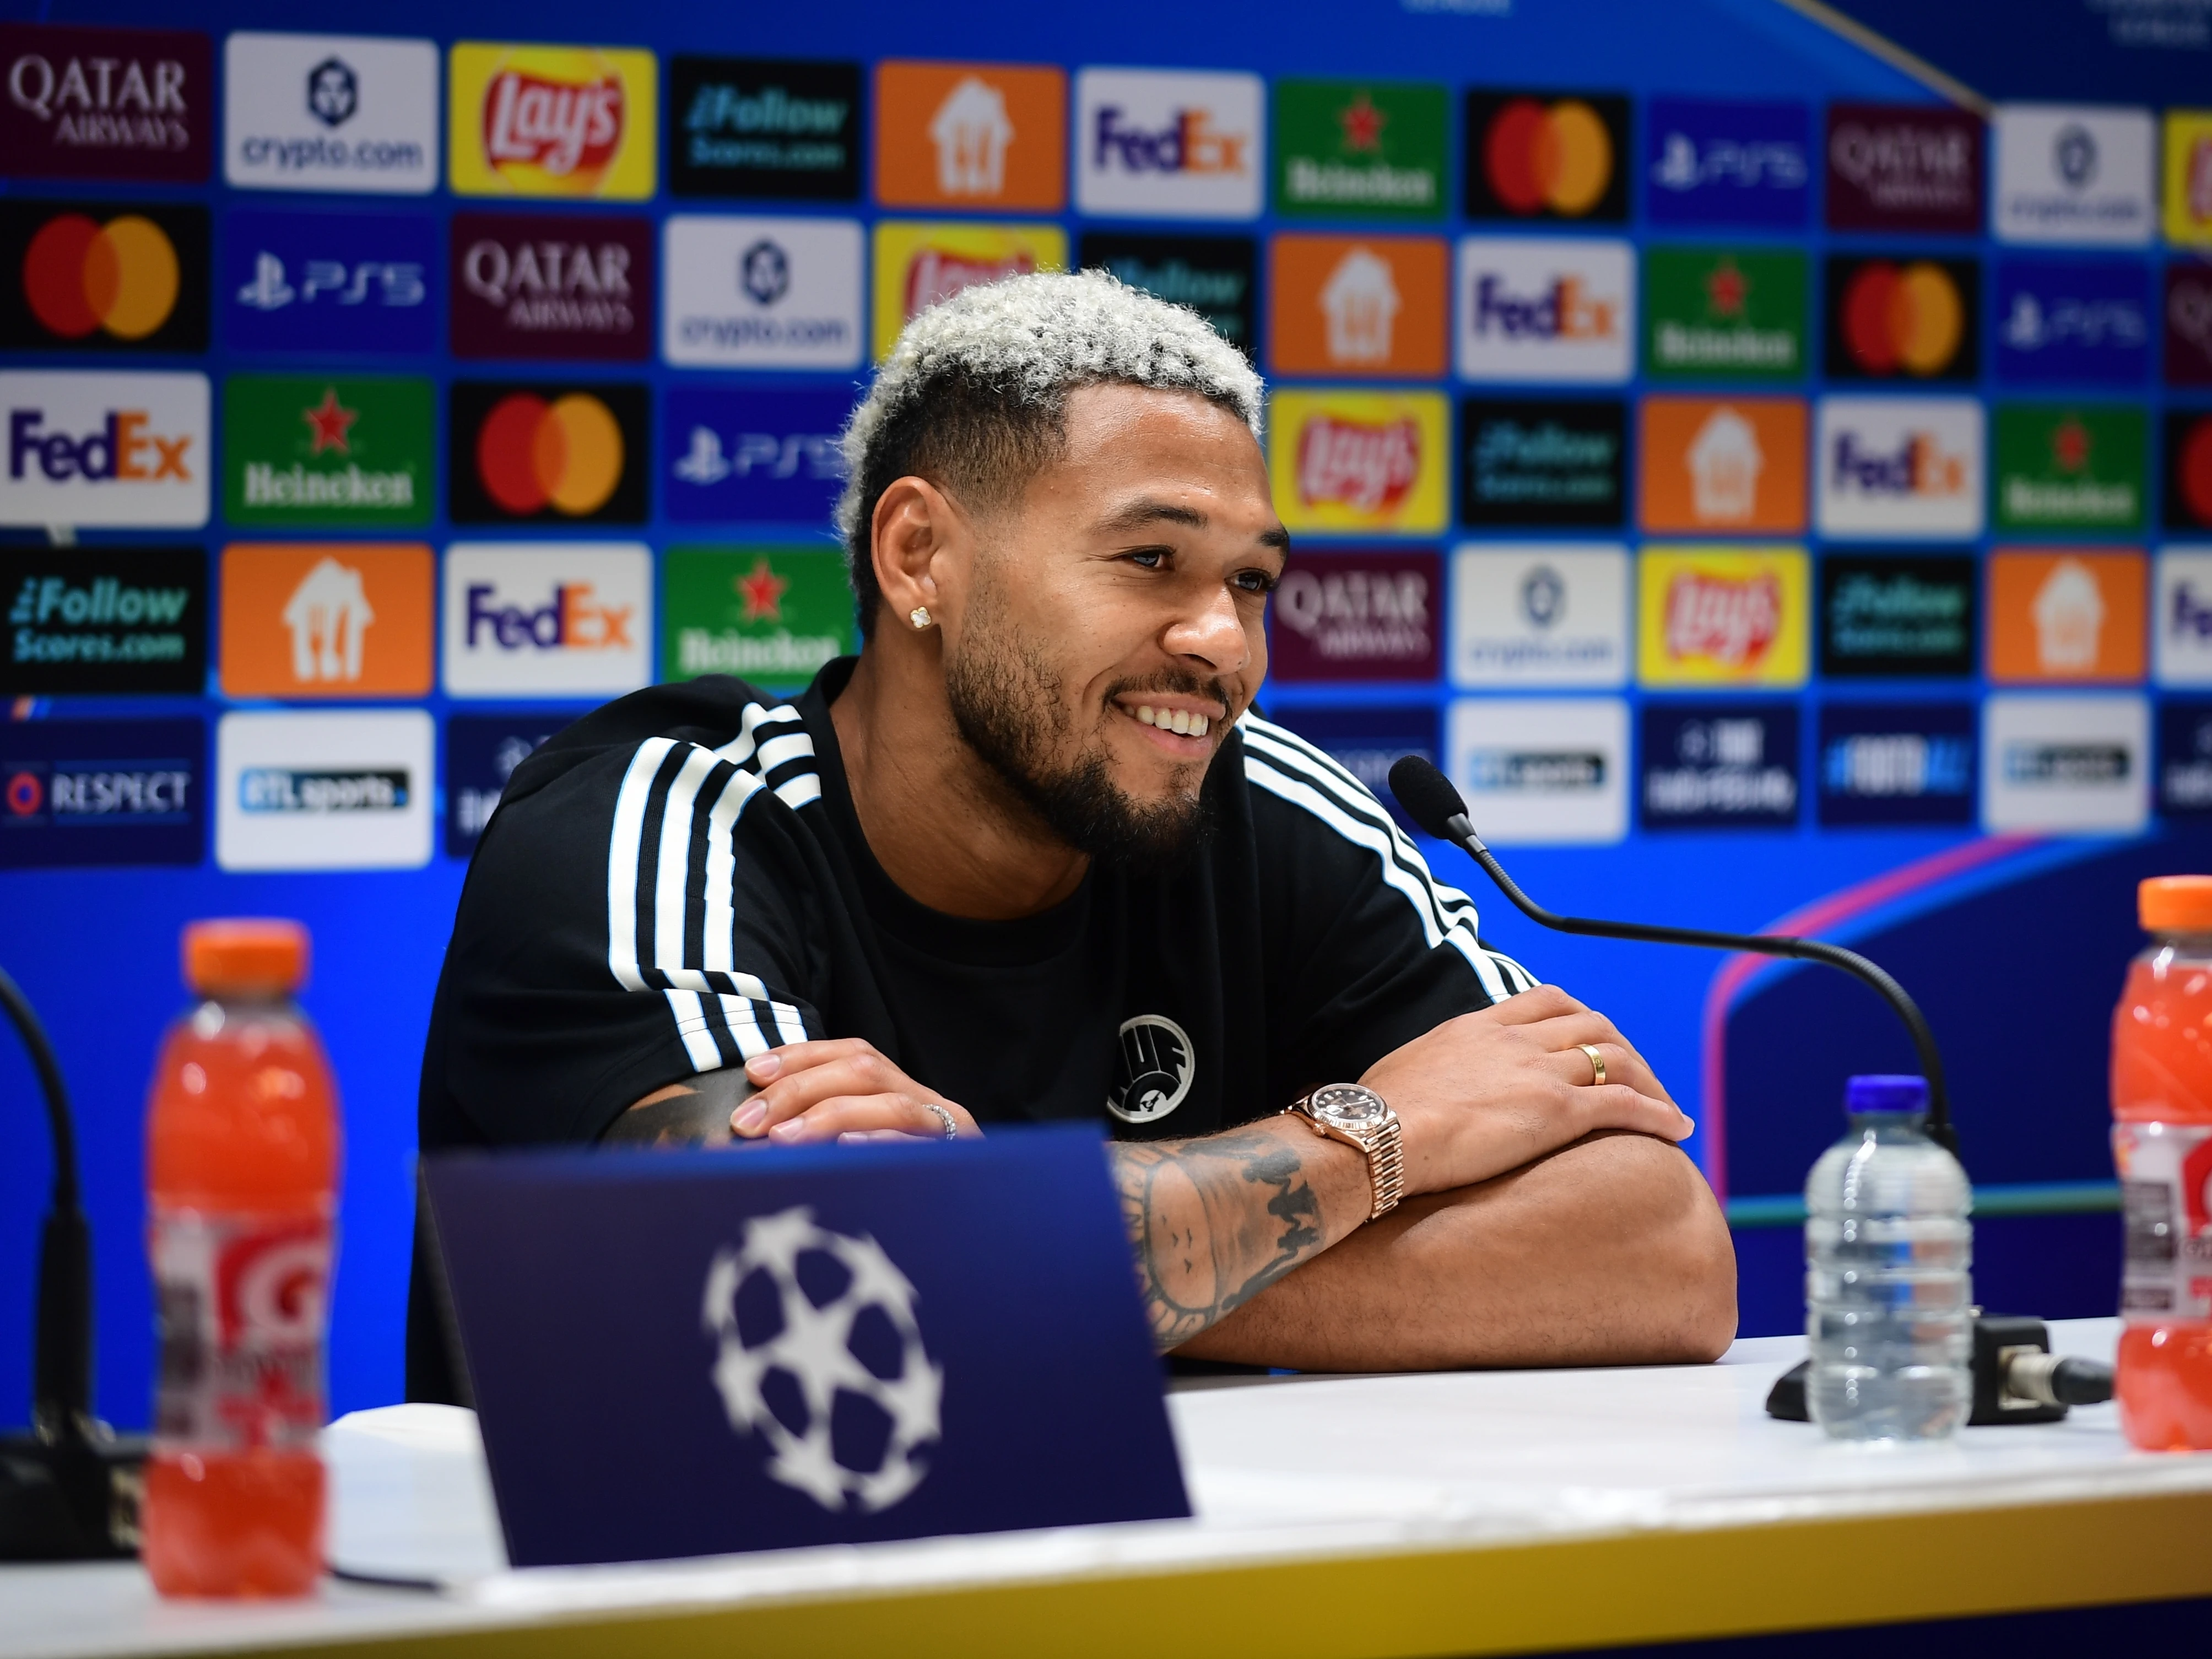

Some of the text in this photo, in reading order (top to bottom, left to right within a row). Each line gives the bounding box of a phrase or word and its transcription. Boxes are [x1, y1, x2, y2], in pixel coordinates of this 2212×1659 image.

[9, 54, 188, 121] QATAR
[55, 114, 190, 150] AIRWAYS
[490, 74, 621, 176] Lay's
[1093, 106, 1246, 175] FedEx
[242, 137, 423, 172] crypto.com
[1286, 155, 1436, 208] Heineken
[303, 259, 426, 307] PS5
[464, 239, 632, 307] QATAR
[507, 298, 634, 331] AIRWAYS
[679, 316, 846, 348] crypto.com
[1477, 273, 1616, 342] FedEx
[9, 407, 193, 484] FedEx
[244, 461, 415, 509] Heineken
[37, 575, 190, 626] Follow
[465, 581, 635, 651] FedEx
[1275, 569, 1431, 641] QATAR
[13, 627, 187, 663] Scores.com
[678, 625, 841, 676] Heineken
[52, 770, 190, 814] RESPECT
